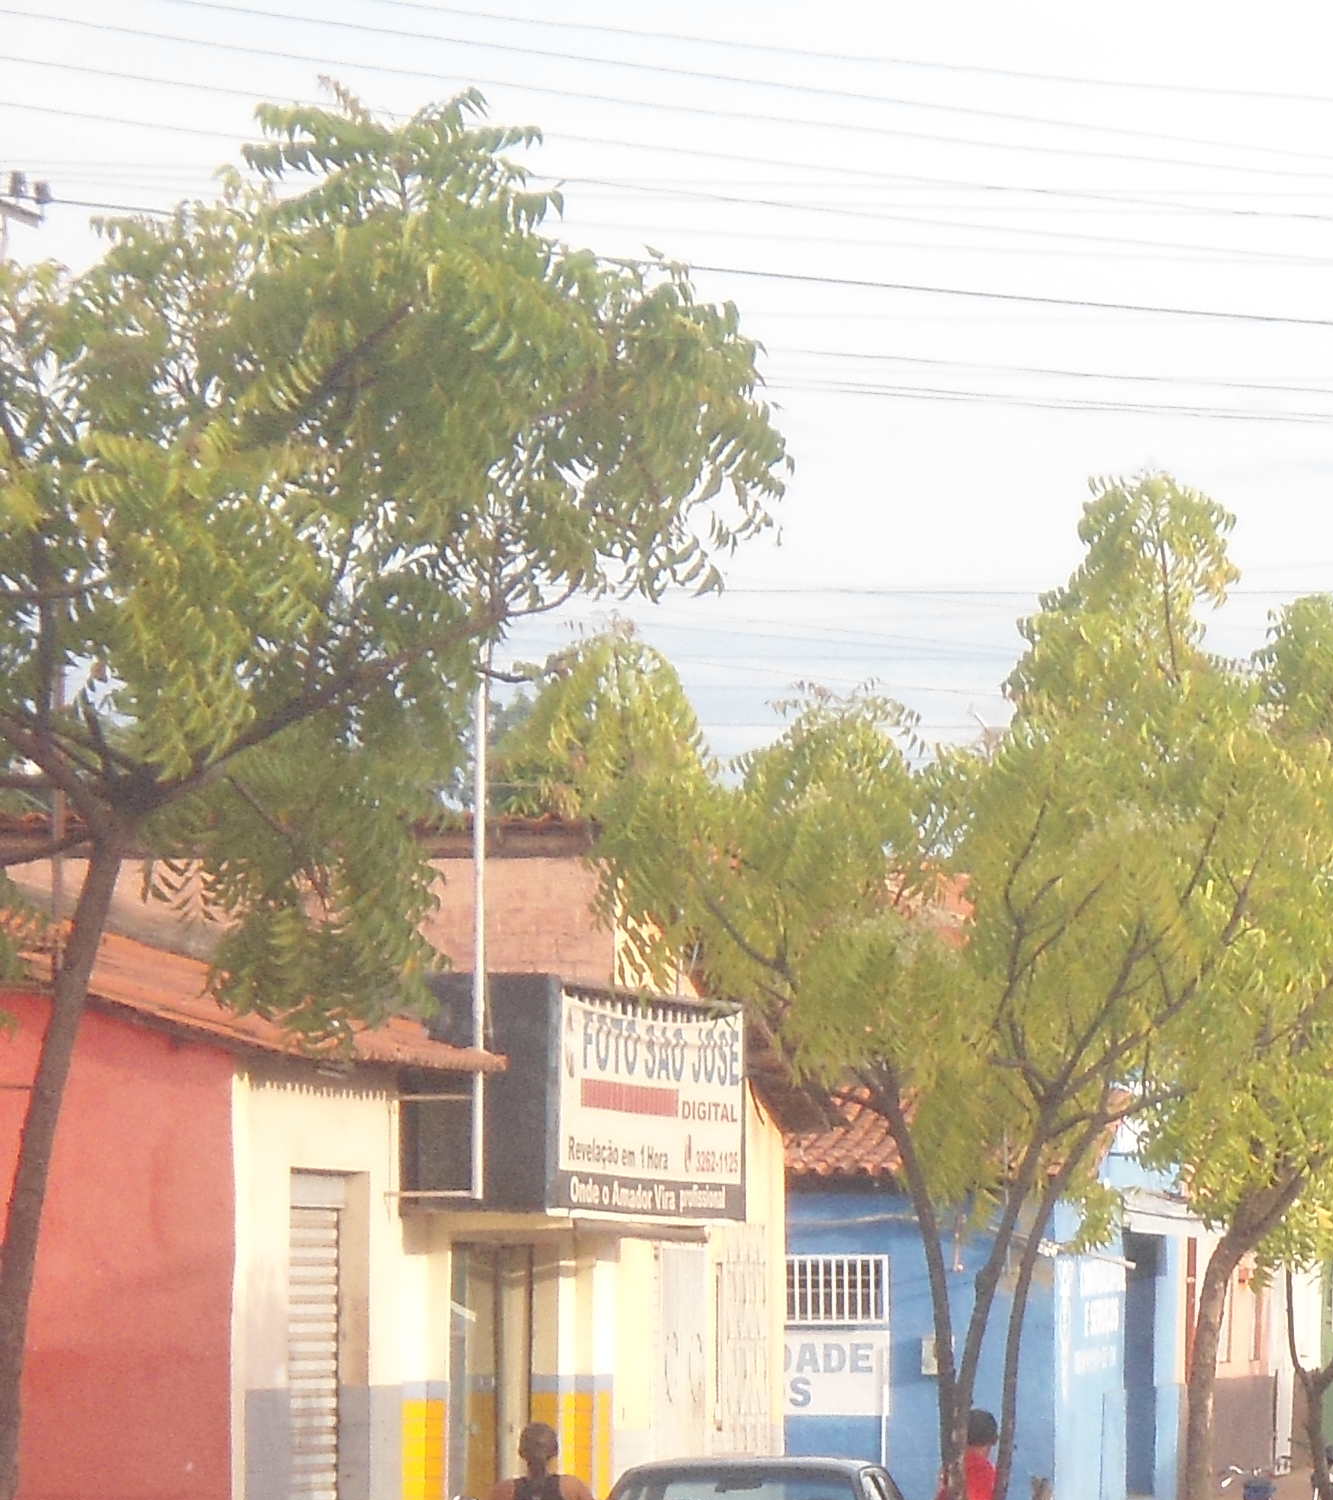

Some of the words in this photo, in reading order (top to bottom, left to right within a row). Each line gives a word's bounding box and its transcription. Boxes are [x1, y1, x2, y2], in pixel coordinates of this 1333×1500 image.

[581, 1011, 641, 1077] FOTO
[681, 1100, 738, 1123] DIGITAL
[621, 1147, 636, 1167] em
[569, 1175, 600, 1205] Onde
[602, 1184, 610, 1206] o
[612, 1180, 653, 1211] Amador
[653, 1184, 676, 1211] Vira
